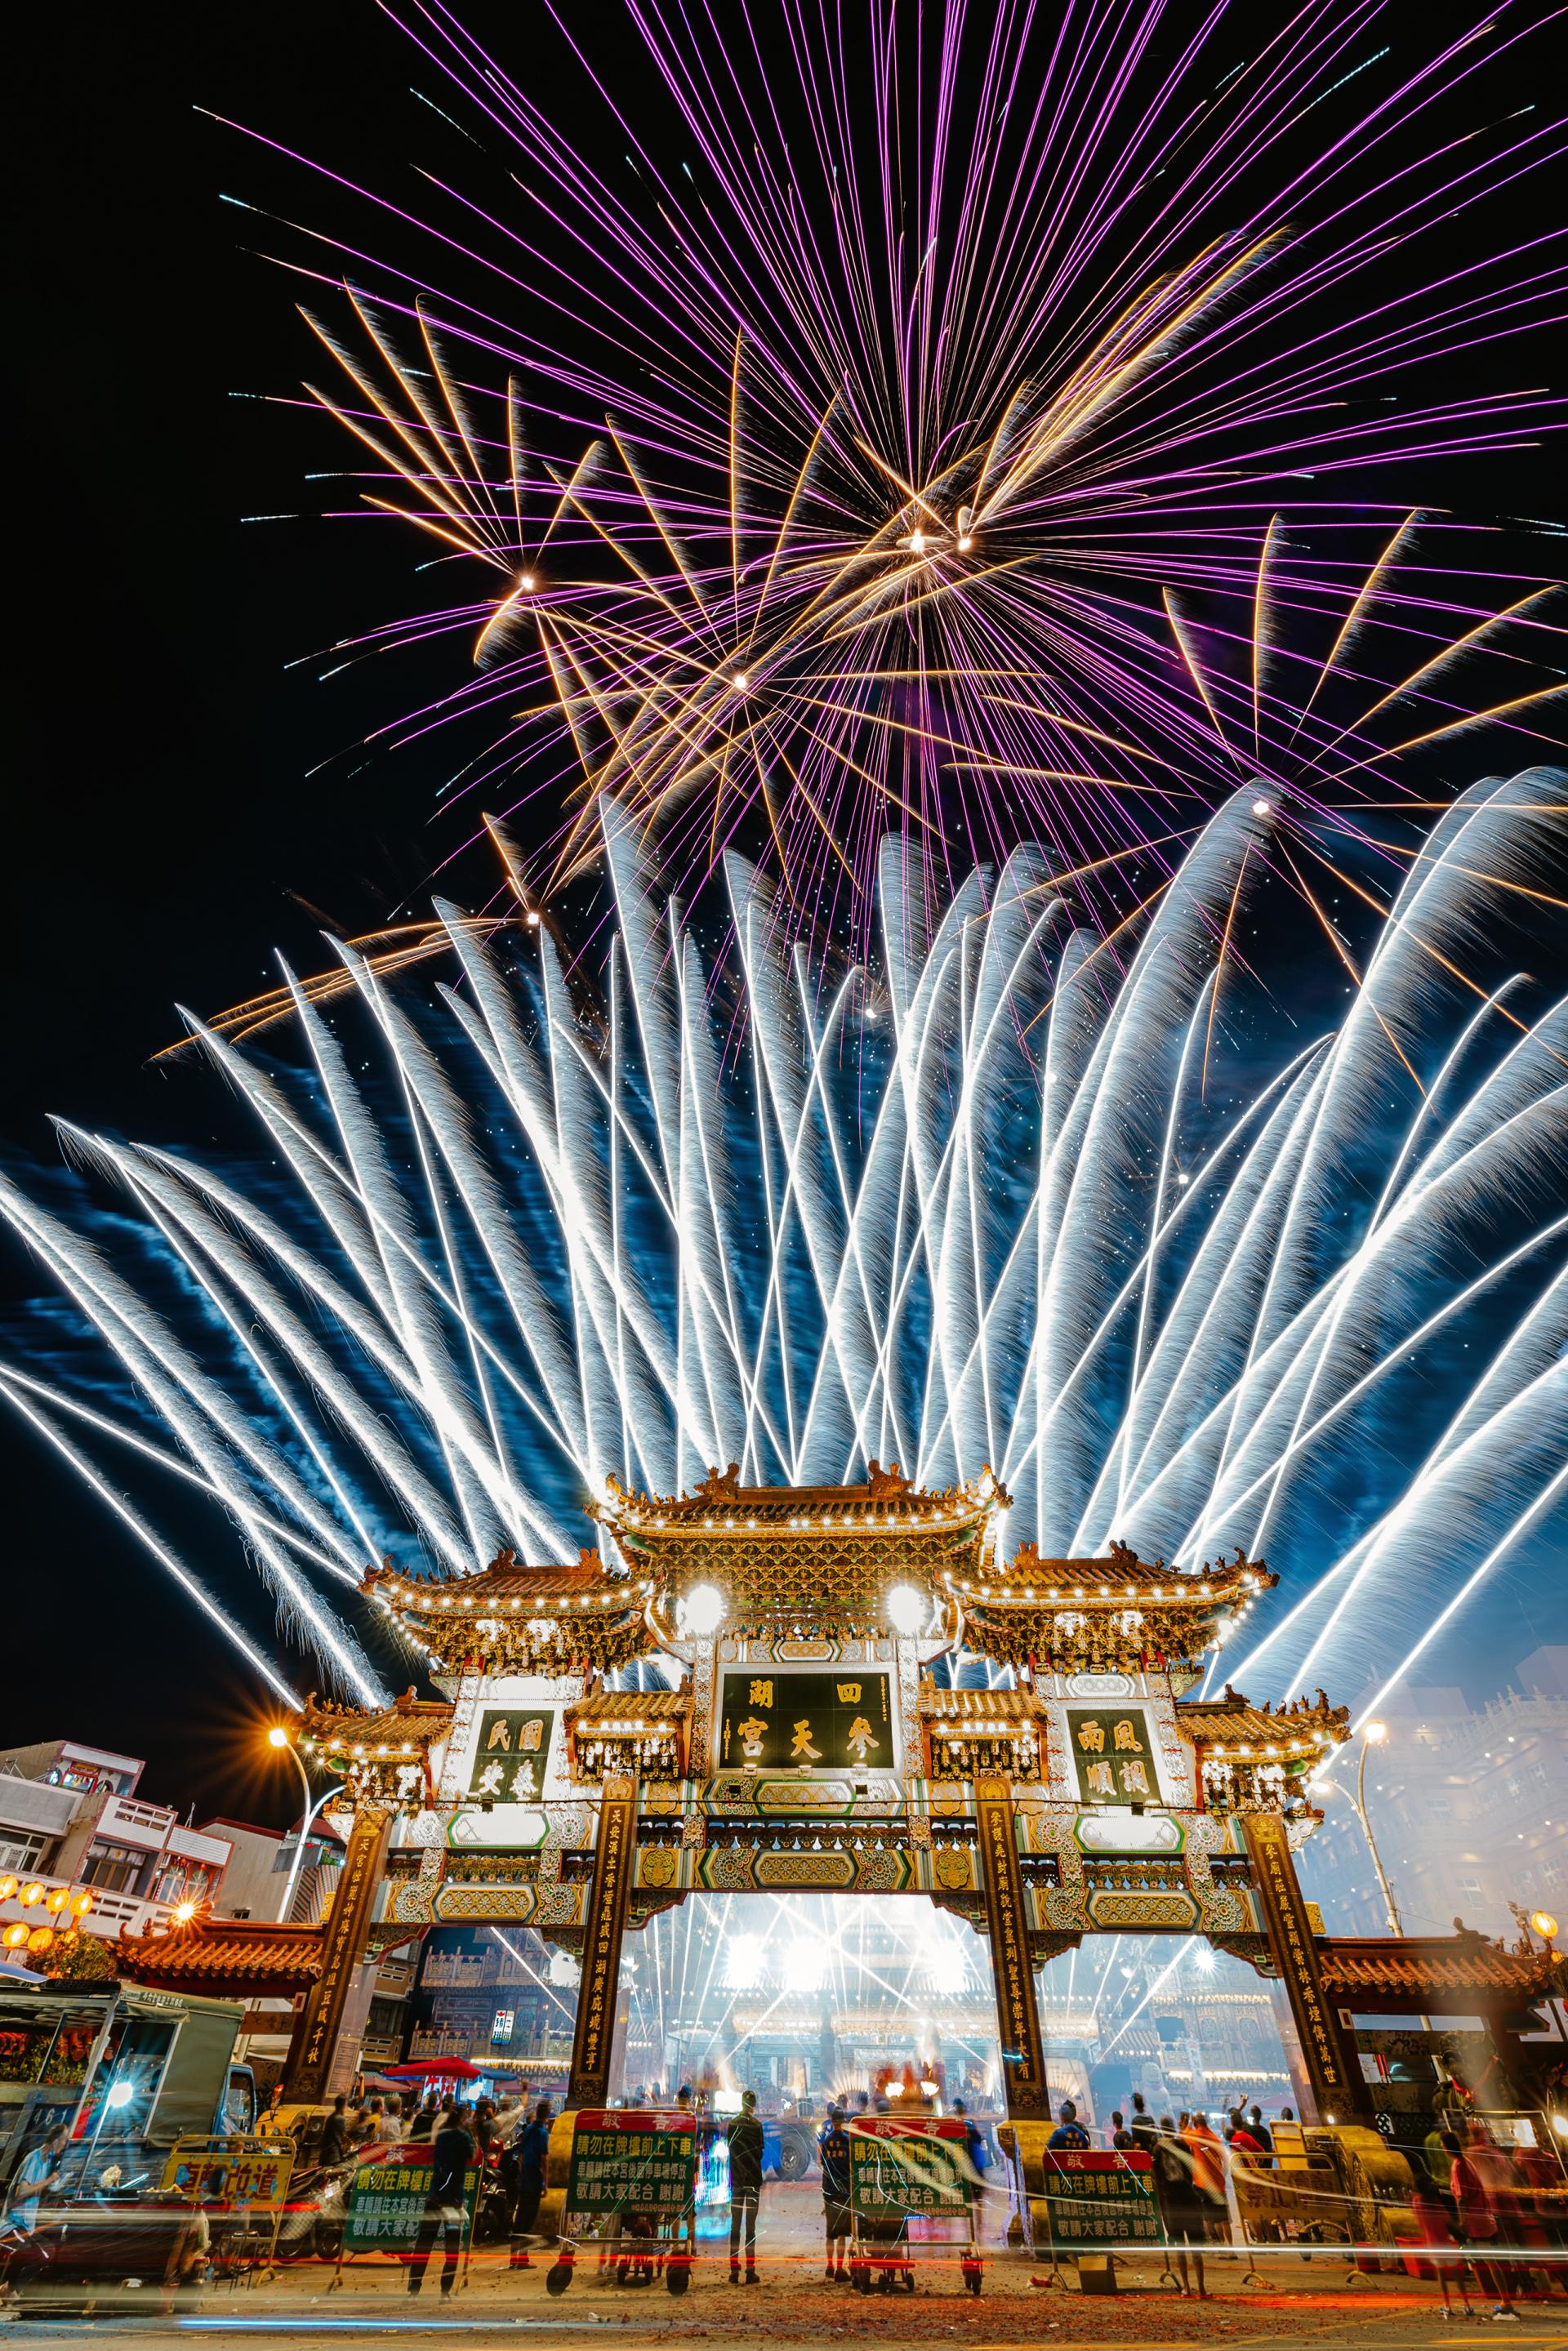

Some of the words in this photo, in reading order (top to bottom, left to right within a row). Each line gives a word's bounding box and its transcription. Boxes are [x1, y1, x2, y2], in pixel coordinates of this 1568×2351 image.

[749, 1679, 862, 1708] 四湖
[737, 1716, 880, 1759] 參天宮
[577, 2135, 692, 2157] 請勿在牌樓前上下車
[576, 2182, 654, 2201] 敬請大家配合
[659, 2184, 685, 2201] 謝謝
[1049, 2175, 1154, 2195] 請勿在牌樓前上下車
[859, 2187, 933, 2205] 敬請大家配合
[1058, 2220, 1129, 2237] 敬請大家配合
[1133, 2220, 1157, 2237] 謝謝
